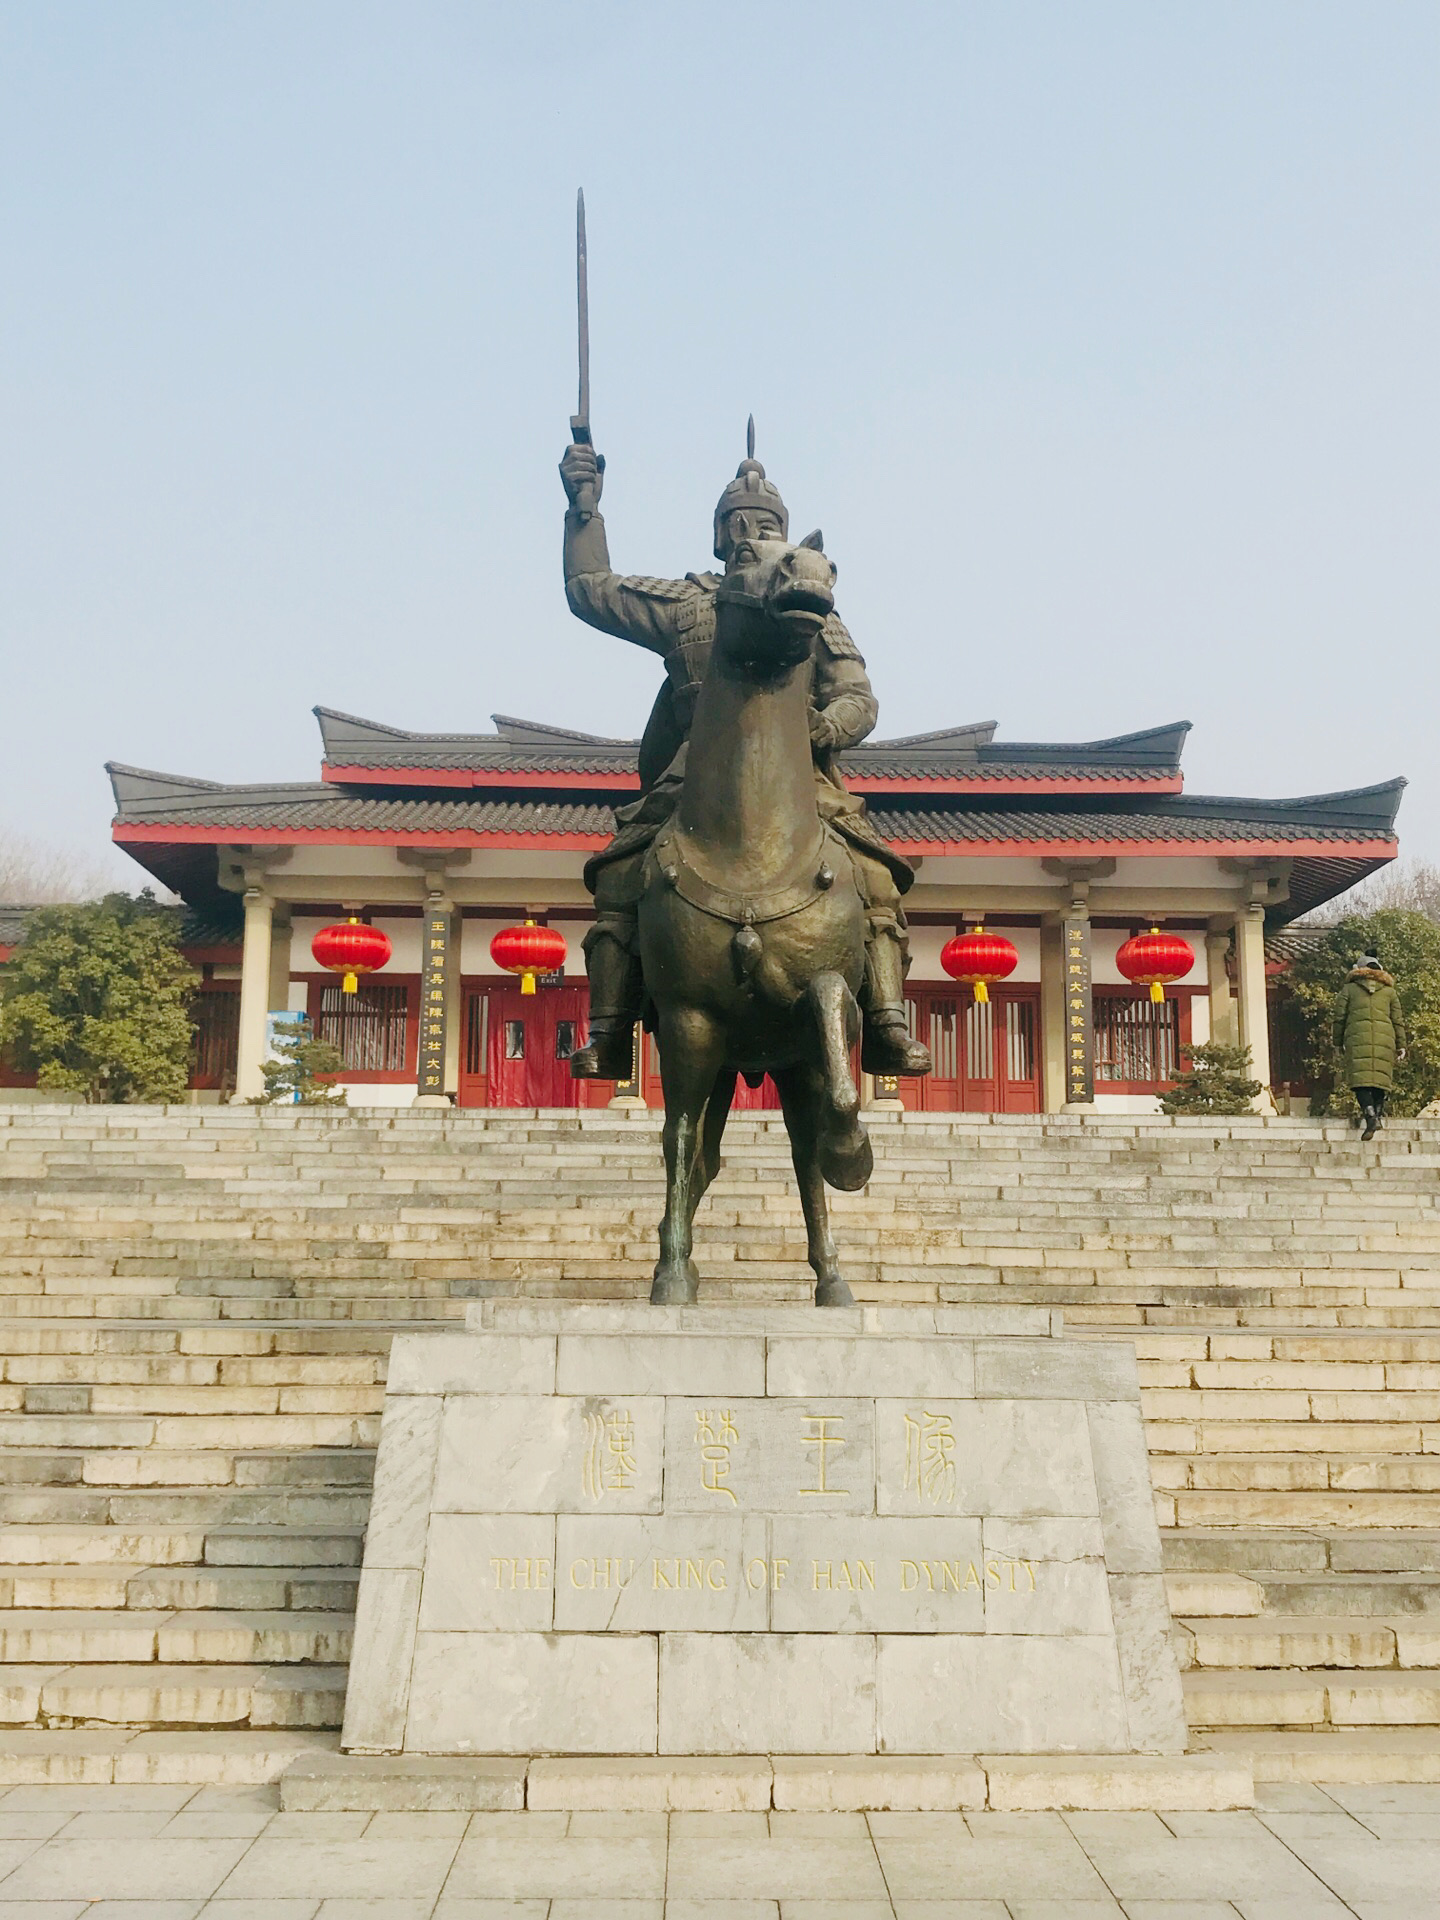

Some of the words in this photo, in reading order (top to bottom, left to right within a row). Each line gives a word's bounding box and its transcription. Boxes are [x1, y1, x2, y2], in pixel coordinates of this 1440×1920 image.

[489, 1557, 551, 1590] THE
[569, 1557, 635, 1590] CHU
[652, 1557, 728, 1591] KING
[746, 1557, 790, 1591] OF
[811, 1558, 876, 1591] HAN
[899, 1559, 1041, 1592] DYNASTY
